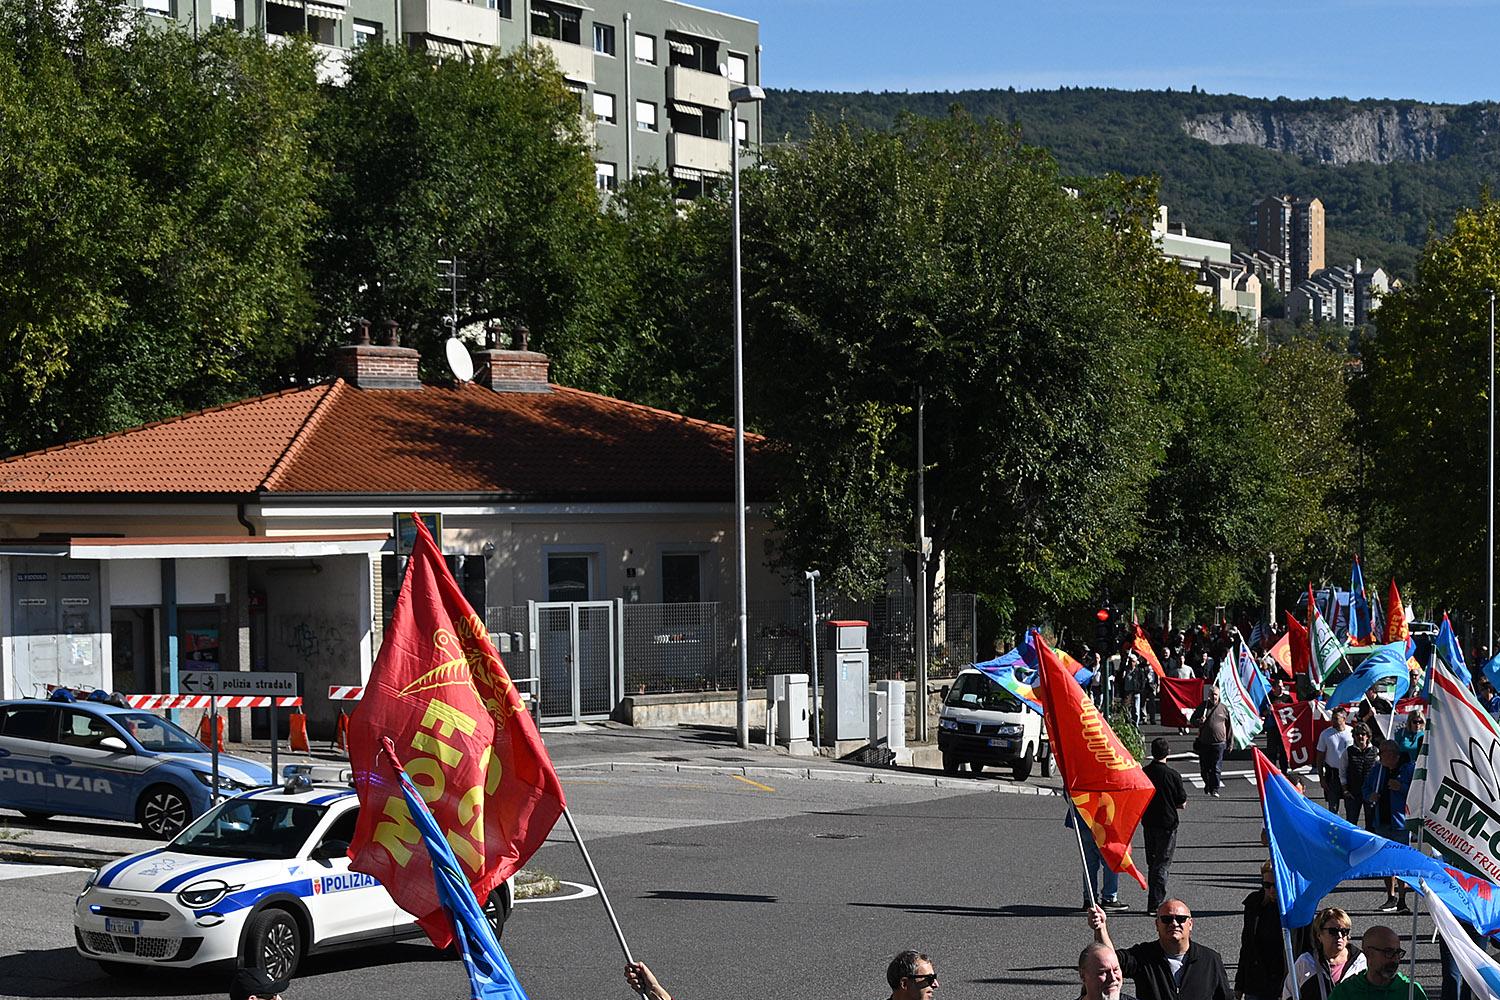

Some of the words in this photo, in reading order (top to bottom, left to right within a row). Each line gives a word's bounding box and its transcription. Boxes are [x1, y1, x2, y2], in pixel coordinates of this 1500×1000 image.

[223, 679, 251, 689] polizia
[255, 679, 293, 689] stradale
[0, 766, 113, 795] POLIZIA
[1424, 816, 1475, 856] MECCANICI
[326, 873, 373, 892] POLIZIA
